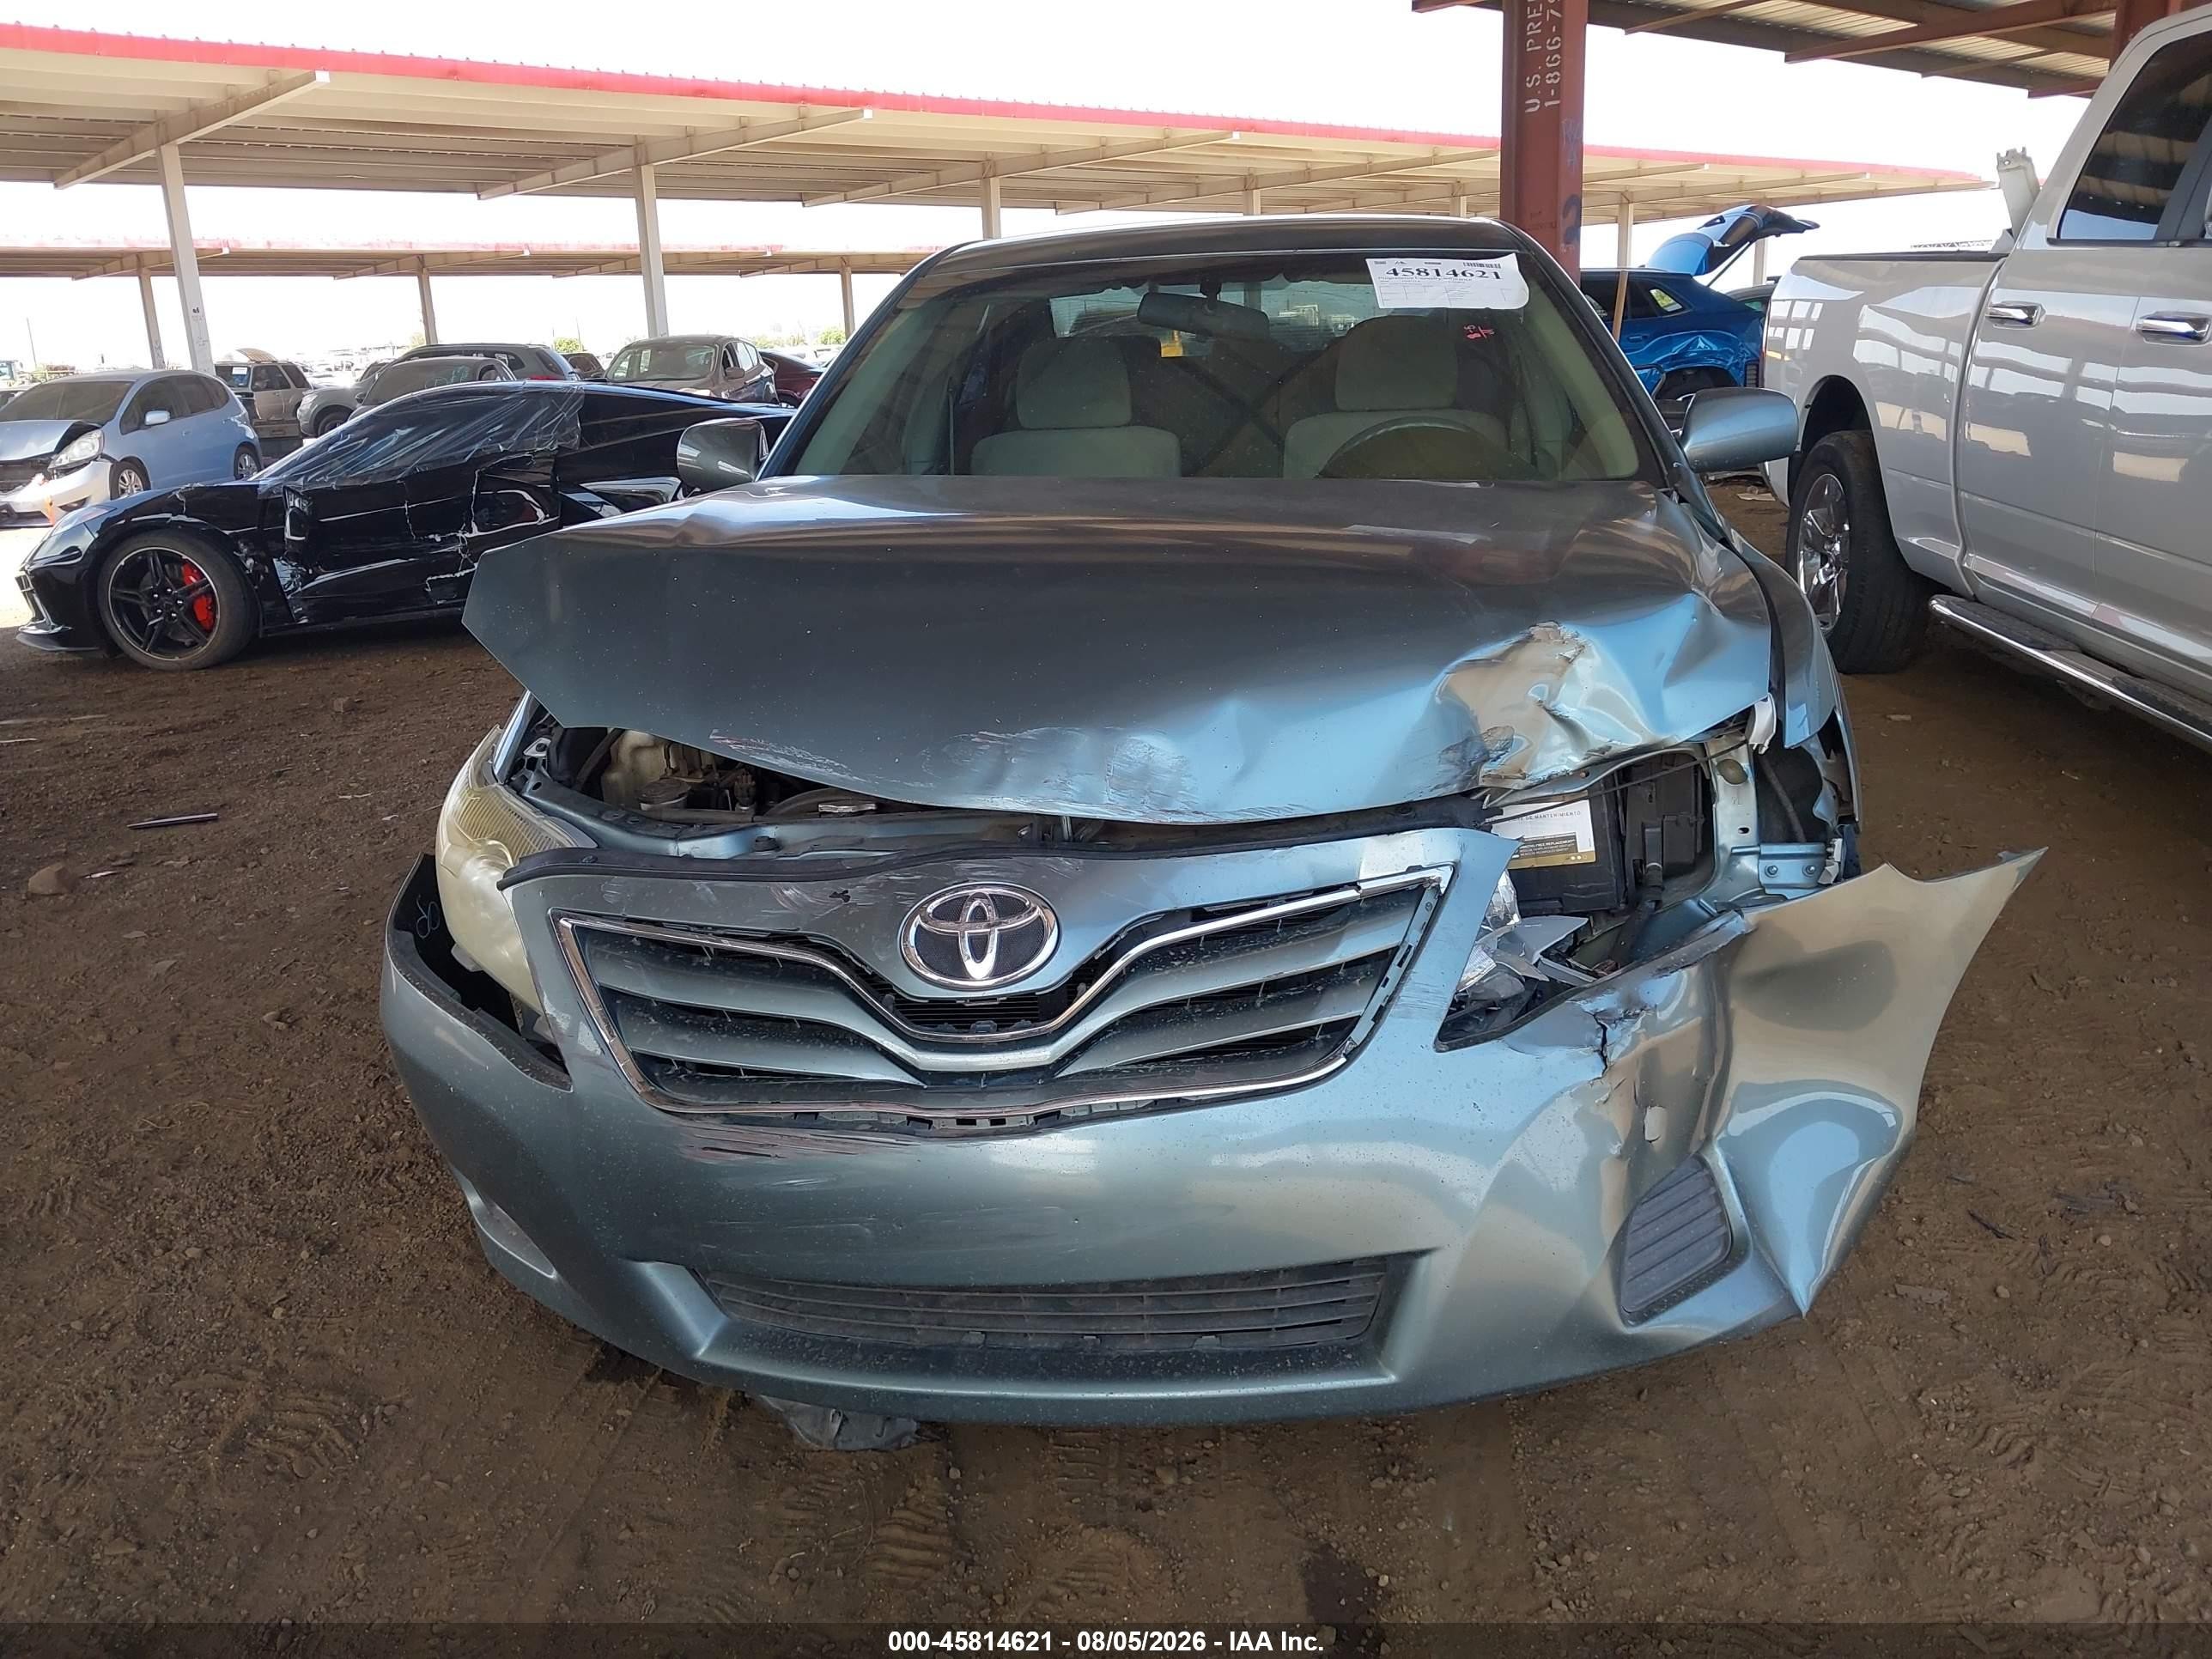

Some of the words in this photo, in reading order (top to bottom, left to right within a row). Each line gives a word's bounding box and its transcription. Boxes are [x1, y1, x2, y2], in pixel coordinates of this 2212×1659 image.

[1526, 0, 1543, 52] PRE
[1525, 65, 1541, 112] U.S.
[1386, 266, 1503, 280] 45814621
